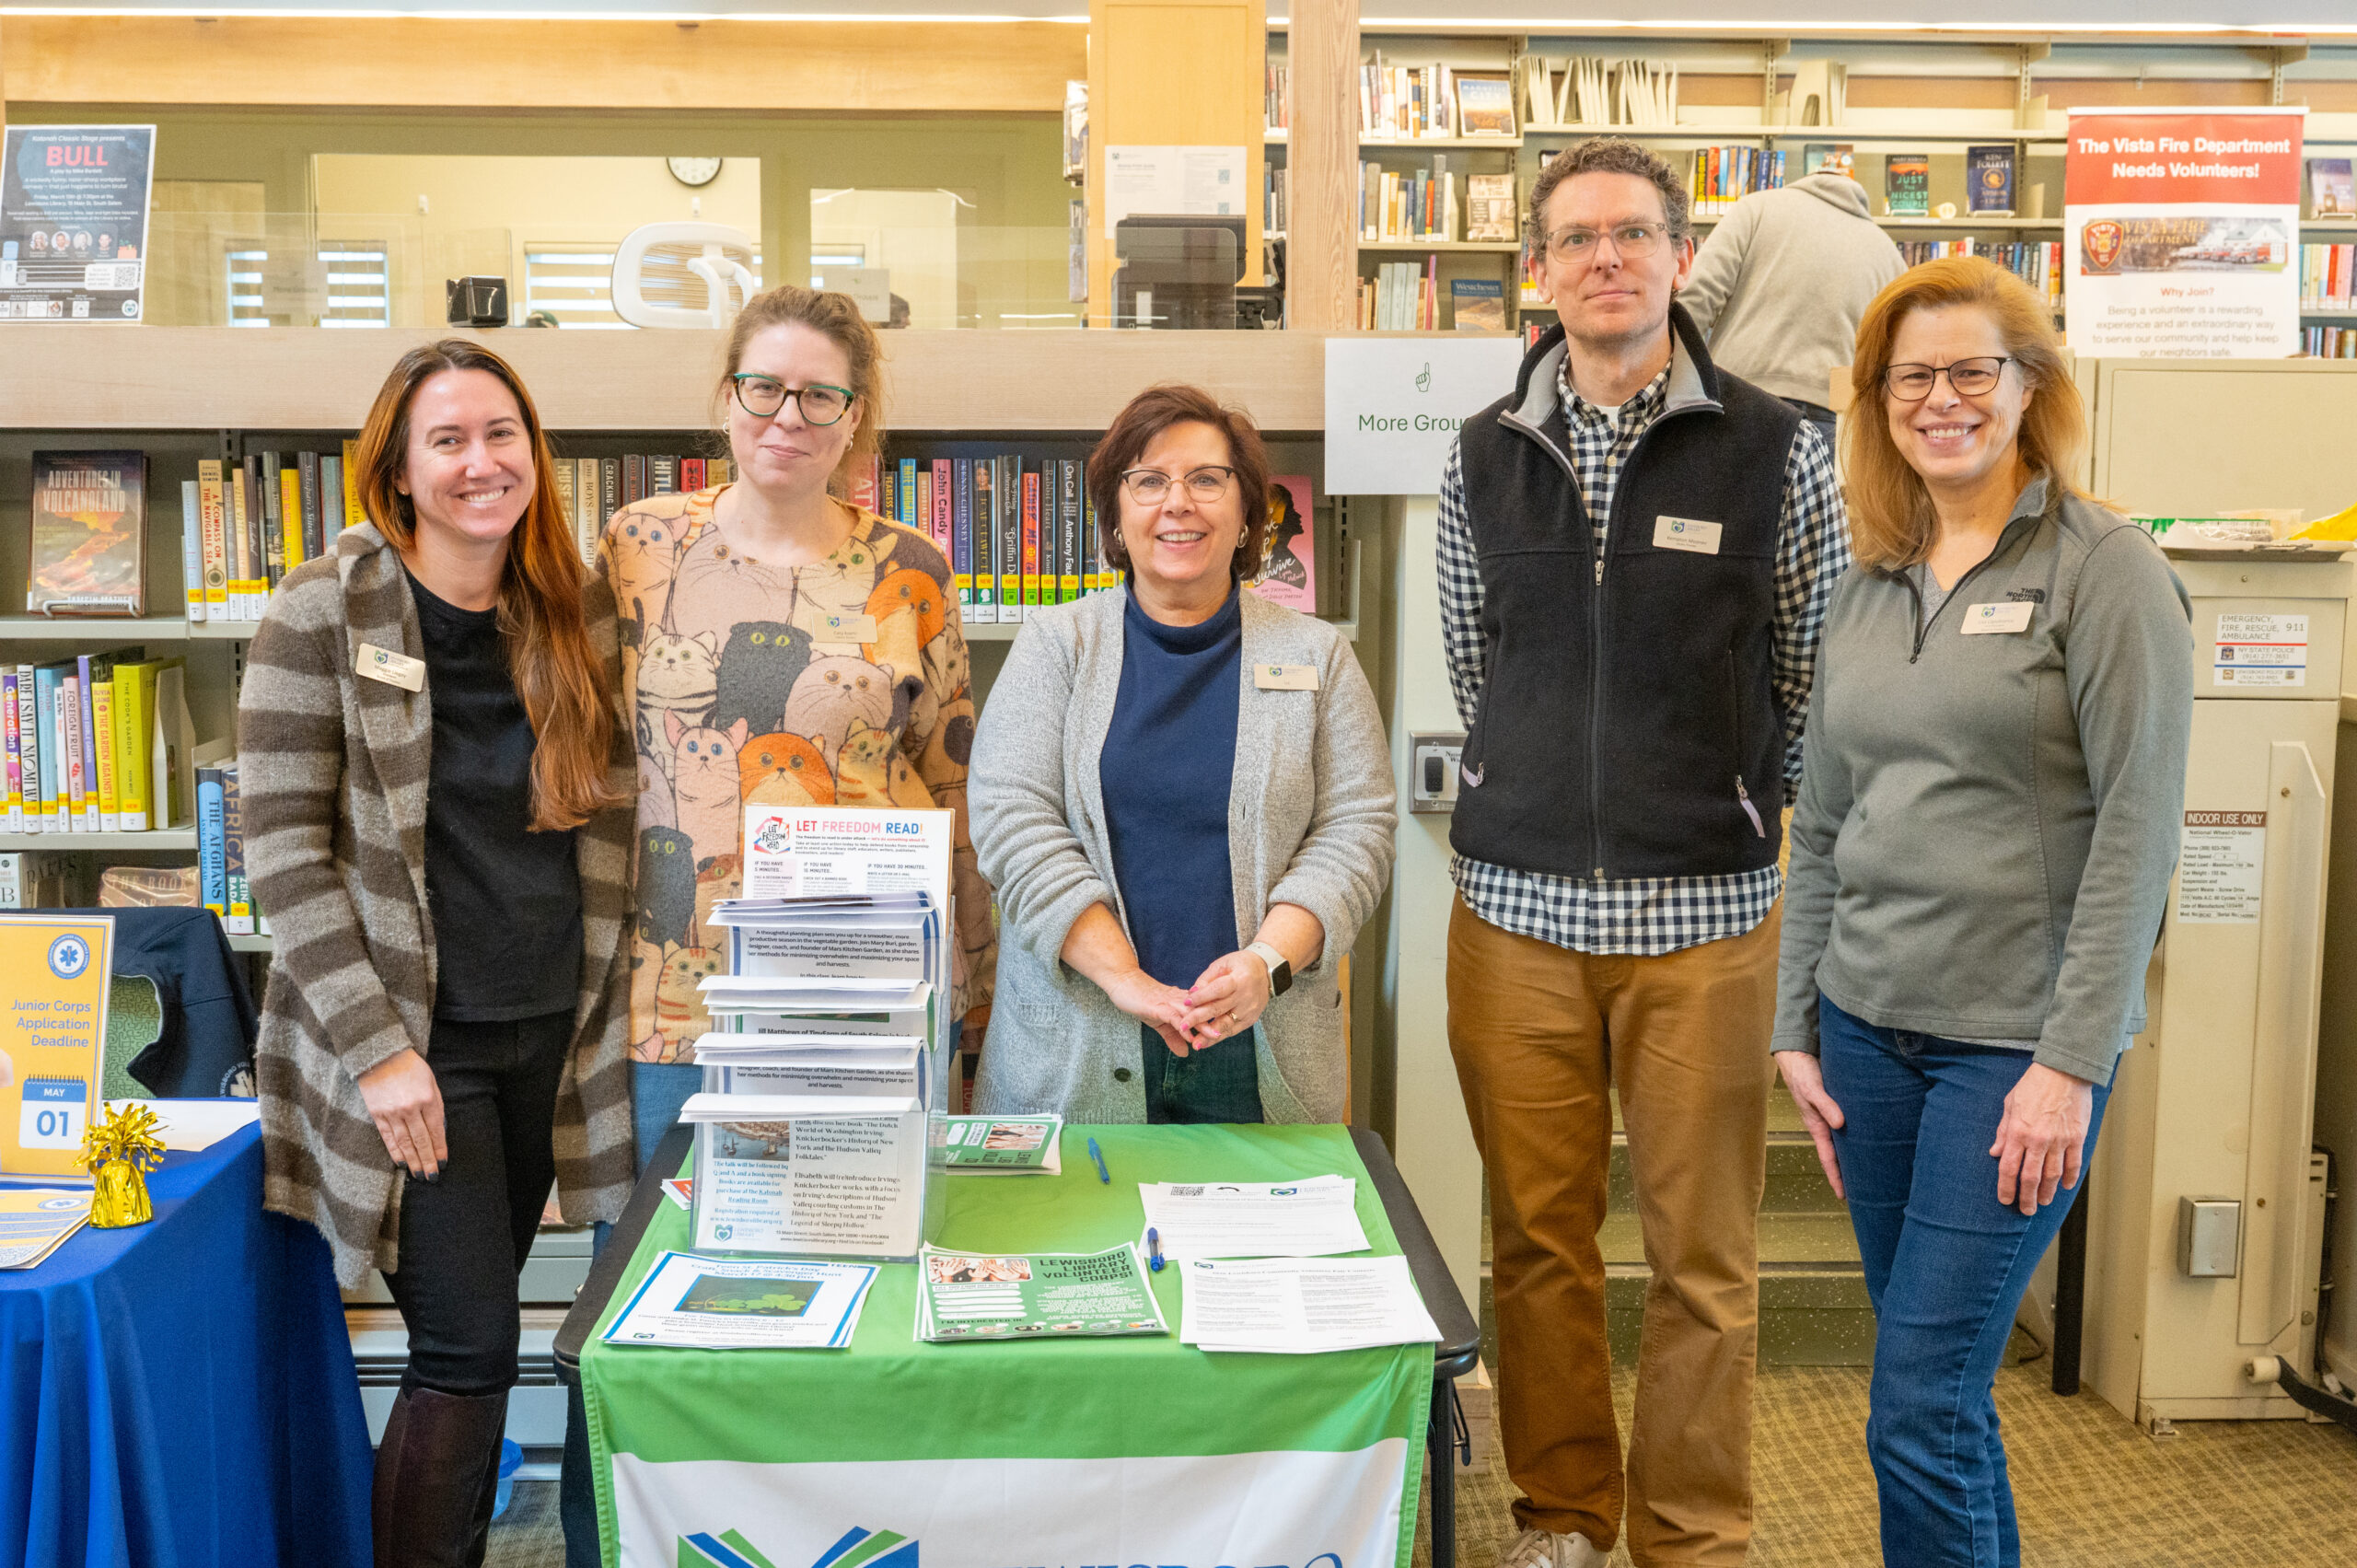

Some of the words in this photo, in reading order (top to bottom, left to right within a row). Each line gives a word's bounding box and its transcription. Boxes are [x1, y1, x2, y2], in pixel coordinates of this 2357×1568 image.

[2077, 138, 2109, 154] The
[2113, 137, 2154, 153] Vista
[2159, 137, 2189, 153] Fire
[2194, 137, 2291, 156] Department
[46, 145, 109, 166] BULL
[2113, 162, 2165, 178] Needs
[2169, 162, 2259, 178] Volunteers!
[1897, 176, 1923, 184] JUST
[2161, 287, 2184, 297] Why
[2188, 287, 2214, 296] Join?
[2107, 306, 2136, 317] Being
[2149, 306, 2195, 315] volunteer
[2199, 306, 2206, 314] is
[2217, 306, 2263, 317] rewarding
[2096, 320, 2151, 330] experience
[2154, 319, 2173, 328] and
[2191, 319, 2252, 330] extraordinary
[2255, 321, 2275, 331] way
[2093, 335, 2103, 343] to
[2154, 334, 2209, 344] community
[2212, 334, 2229, 343] and
[2232, 334, 2252, 344] help
[2256, 335, 2279, 344] keep
[2160, 348, 2208, 358] neighbors
[1358, 414, 1408, 431] More
[49, 470, 108, 488] ADVENTURES
[110, 470, 122, 488] IN
[938, 468, 946, 494] John
[1066, 466, 1074, 480] On
[304, 464, 314, 509] Shakespeare's
[586, 482, 594, 507] BOYS
[44, 491, 125, 512] VOLCANOLAND
[606, 507, 614, 520] THE
[938, 499, 947, 534] Candy
[213, 505, 221, 541] COMPASS
[1027, 528, 1036, 545] ME
[1064, 520, 1074, 555] Anthony
[215, 545, 221, 558] ON
[1005, 528, 1016, 563] Griffin
[2222, 615, 2273, 623] EMERGENCY,
[2286, 623, 2305, 632] 911
[19, 670, 32, 693] DARE
[6, 686, 17, 749] Generation
[21, 705, 34, 725] SAY
[67, 691, 76, 730] FOREIGN
[99, 714, 108, 732] THE
[21, 727, 34, 737] IT
[70, 733, 78, 758] FRUIT
[100, 734, 110, 761] GARDEN
[7, 752, 18, 762] M
[23, 745, 37, 784] NAOMI
[102, 763, 111, 796] AGAINST
[209, 800, 220, 827] THE
[2188, 813, 2220, 824] INDOOR
[2223, 814, 2239, 824] USE
[2242, 814, 2263, 824] ONLY
[225, 779, 243, 871] AFRICA
[768, 824, 779, 833] LET
[796, 820, 818, 831] LET
[822, 821, 881, 833] FREEDOM
[886, 823, 923, 834] READ!
[762, 832, 785, 842] FREEDOM
[767, 841, 779, 849] READ
[210, 832, 222, 899] AFGHANS
[11, 1000, 51, 1011] Junior
[54, 1000, 91, 1013] Corps
[17, 1016, 90, 1030] Application
[31, 1035, 88, 1048] Deadline
[43, 1088, 65, 1097] MAY
[37, 1110, 68, 1137] 01
[1039, 1251, 1126, 1266] LEWISBORO
[1063, 1258, 1127, 1272] LIBRARY
[1042, 1265, 1130, 1278] VOLUNTEER
[1080, 1272, 1133, 1282] CORPS!
